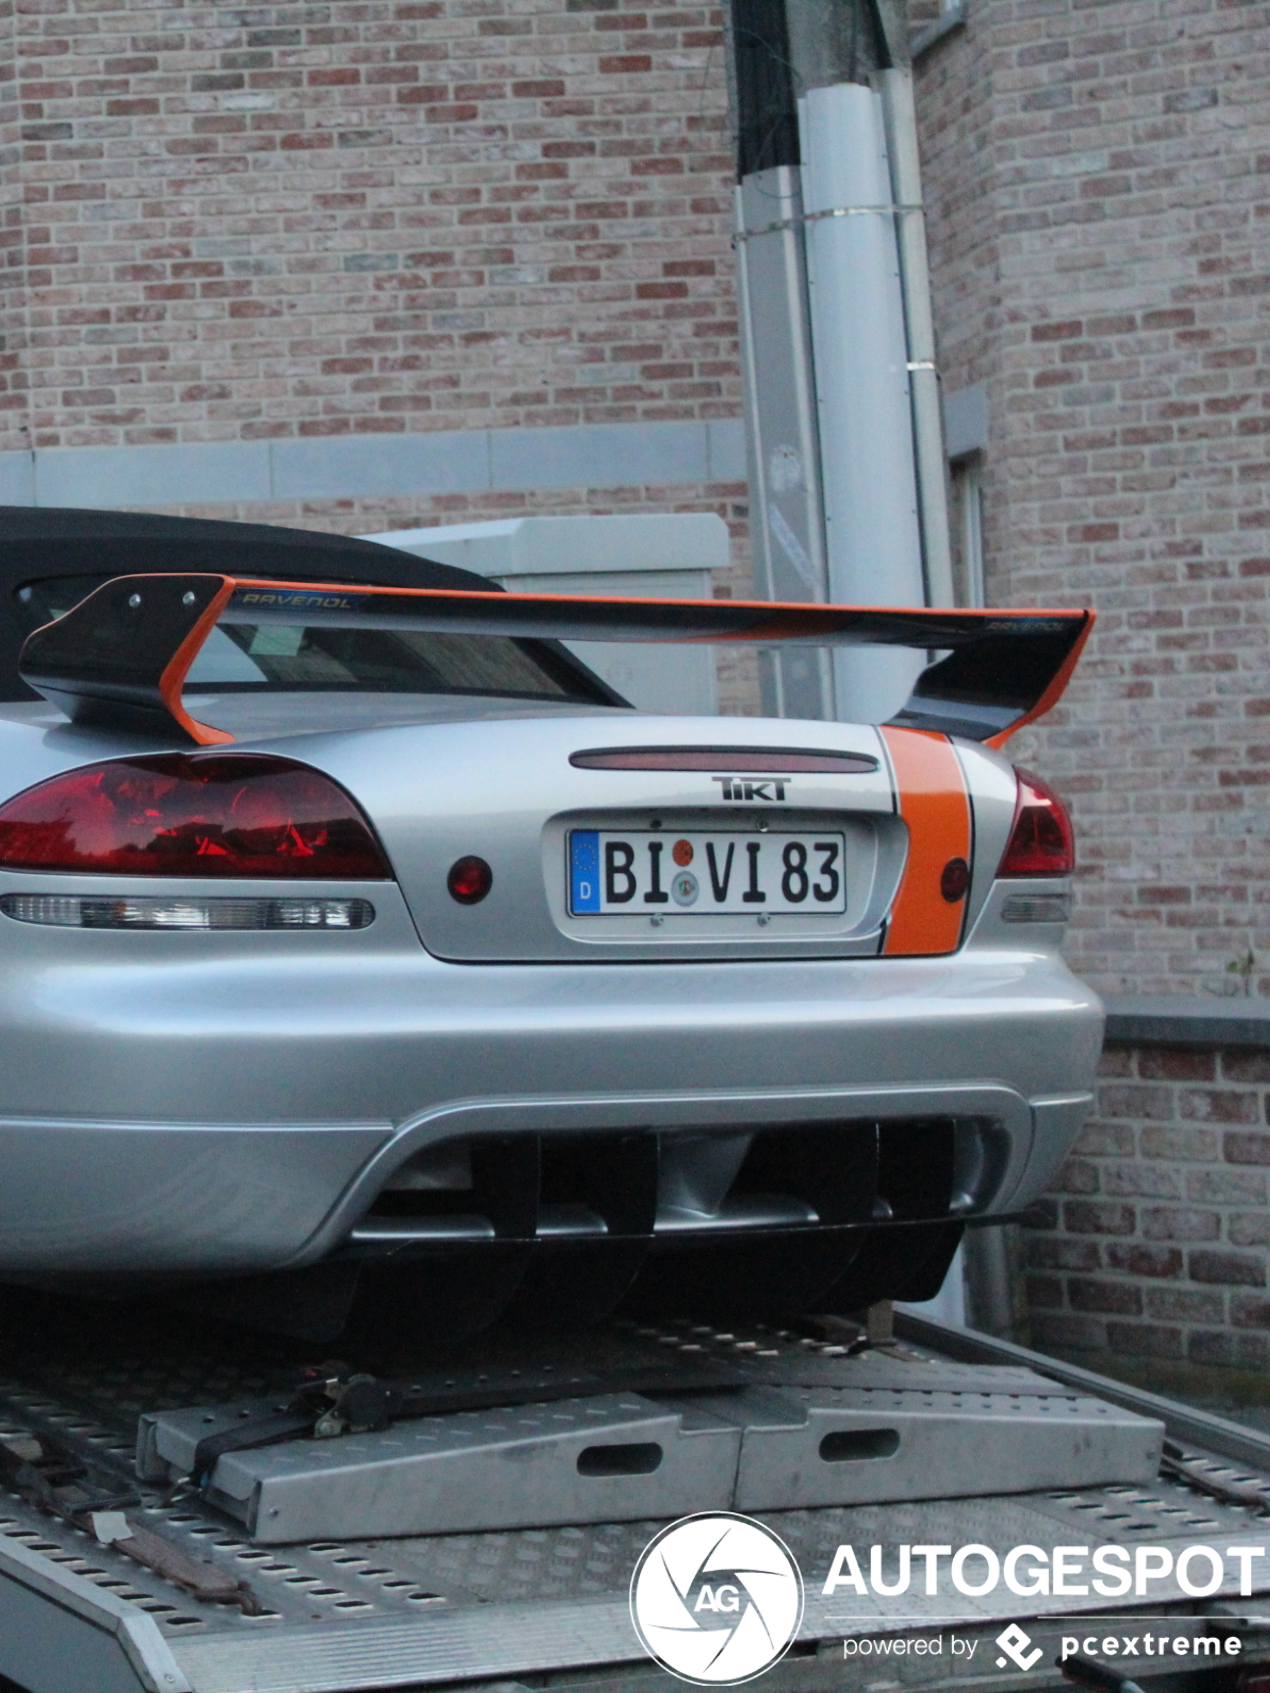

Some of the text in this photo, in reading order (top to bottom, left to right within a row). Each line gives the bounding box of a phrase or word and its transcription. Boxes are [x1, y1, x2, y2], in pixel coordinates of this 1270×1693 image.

[242, 593, 352, 609] RAVENOL
[605, 841, 839, 904] BI VI 83
[579, 882, 591, 899] D
